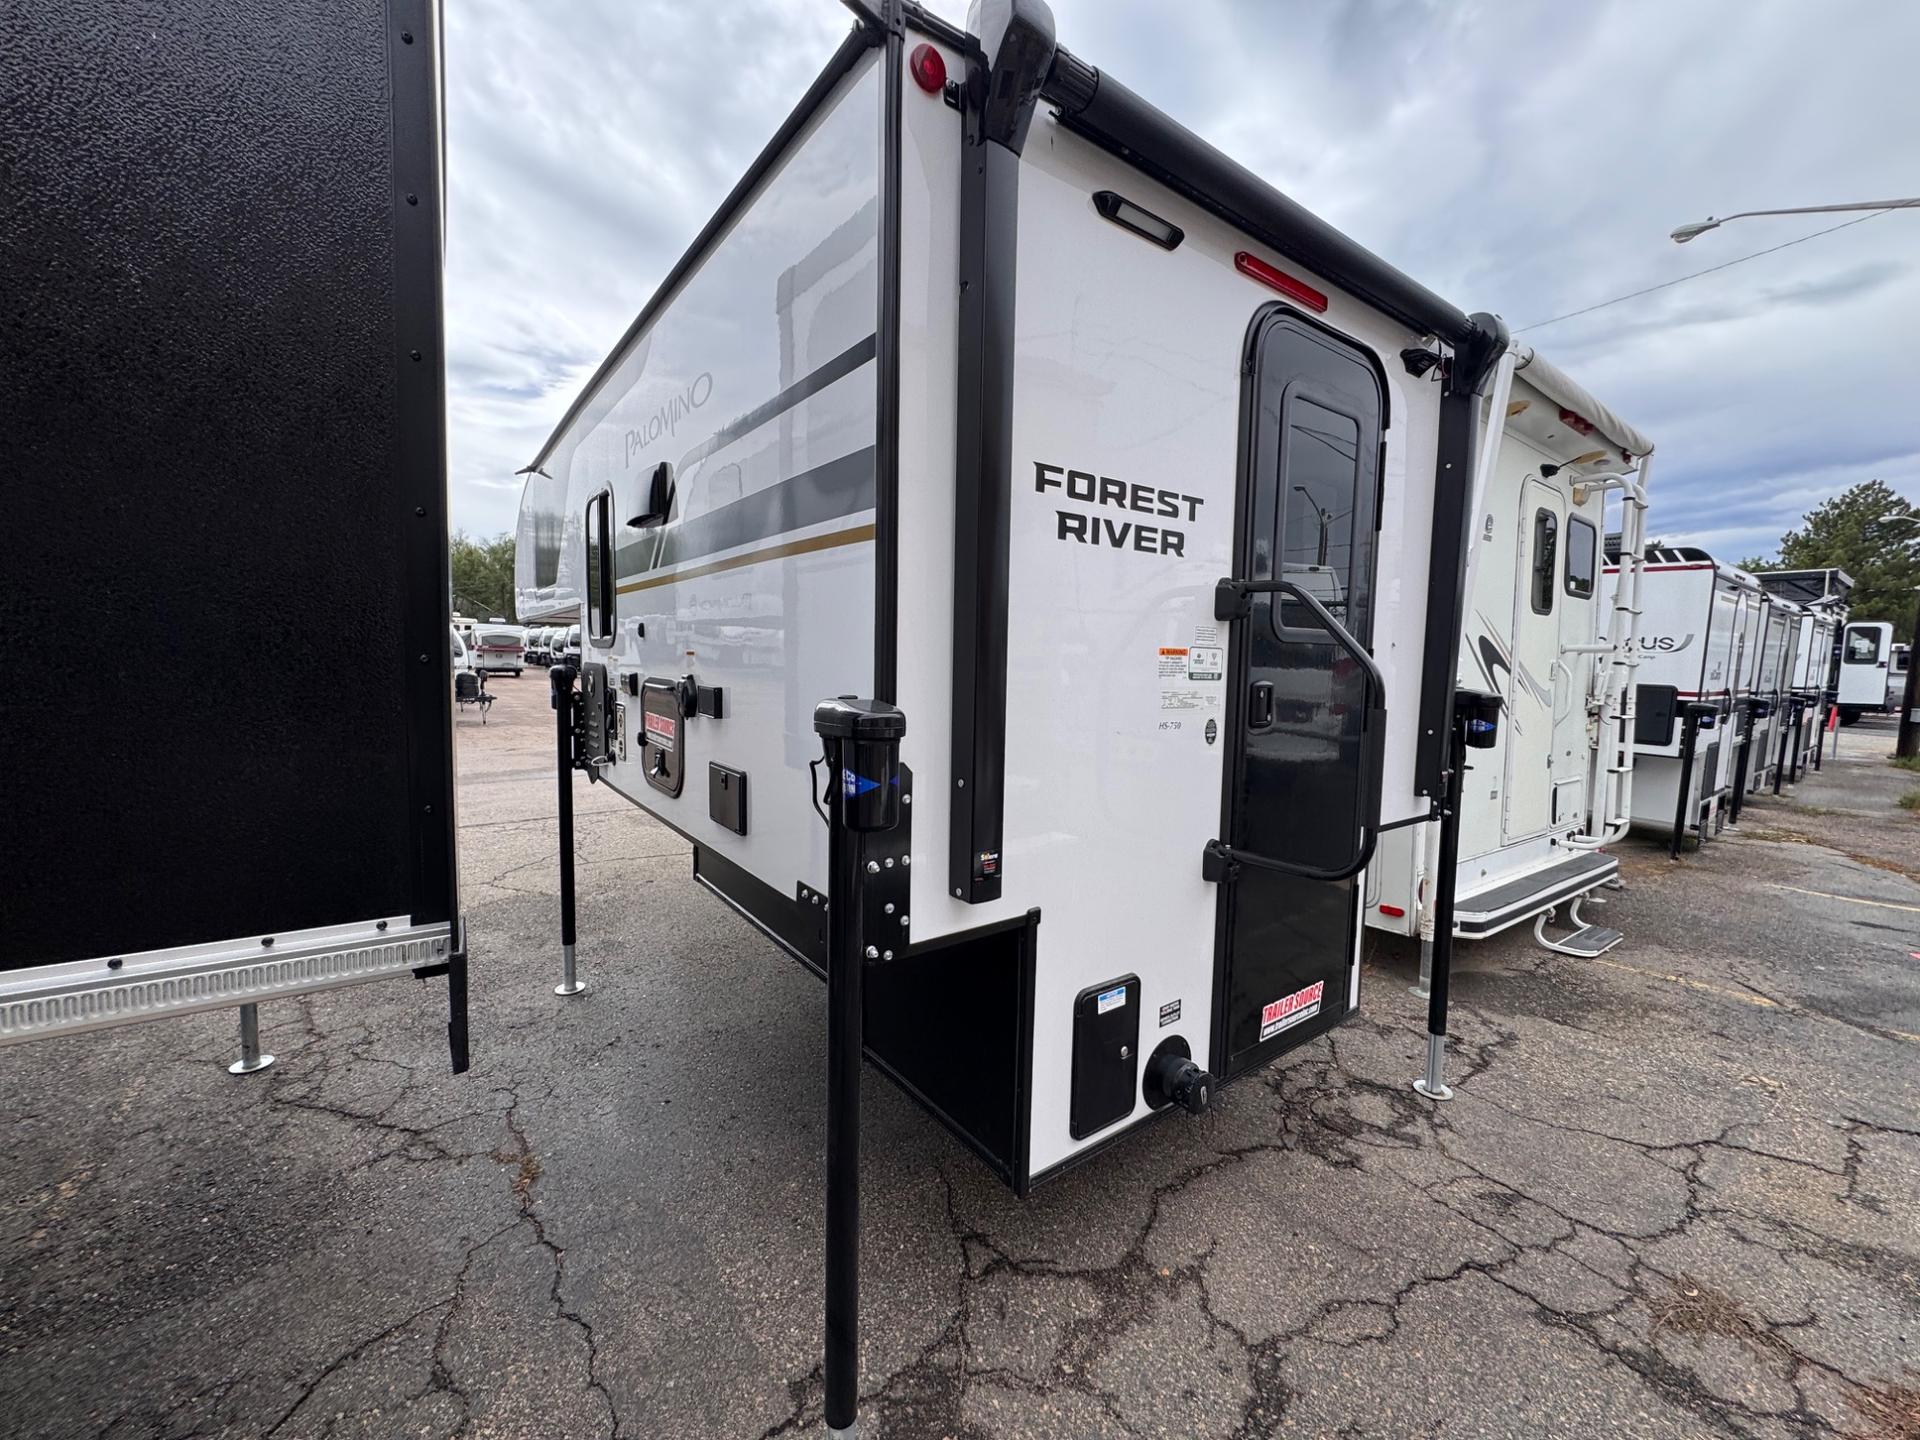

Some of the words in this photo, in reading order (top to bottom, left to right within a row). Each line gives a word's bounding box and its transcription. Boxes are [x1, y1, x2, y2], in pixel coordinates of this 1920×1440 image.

[625, 372, 713, 469] PALOMINO
[1033, 461, 1204, 522] FOREST
[1056, 510, 1184, 558] RIVER
[1263, 995, 1294, 1025] TRAILER
[1294, 983, 1322, 1010] SOURCE
